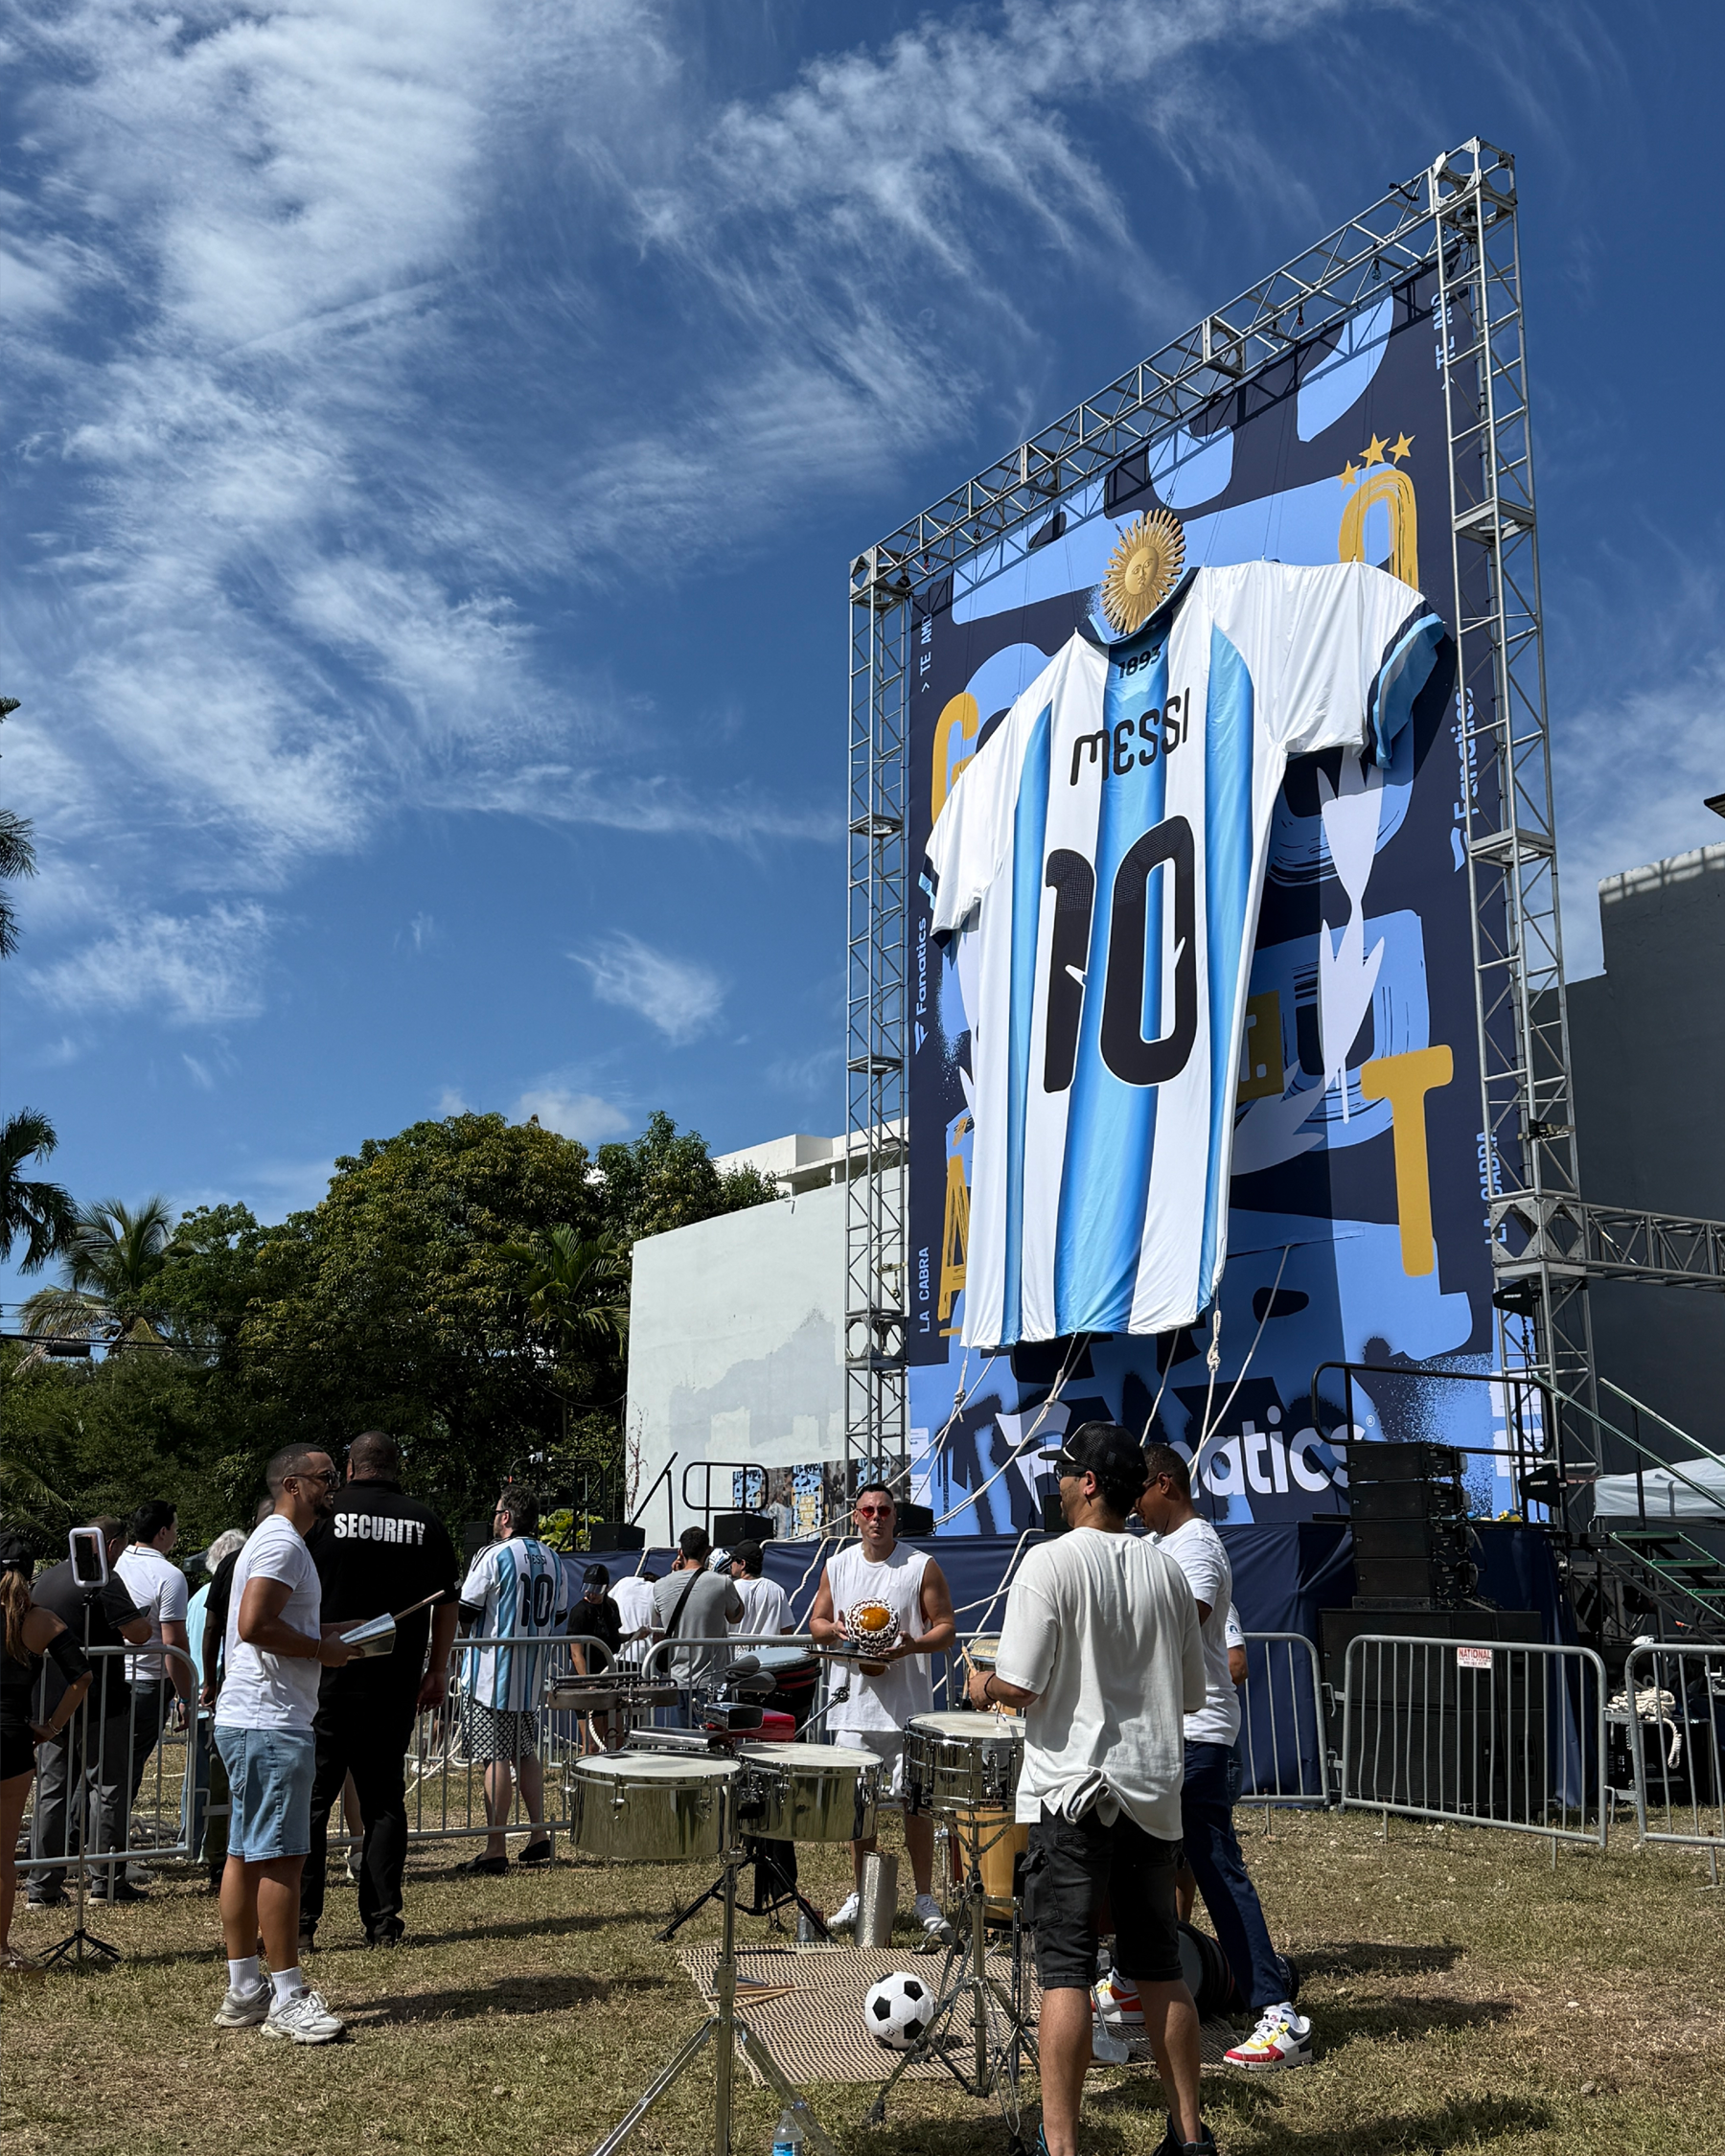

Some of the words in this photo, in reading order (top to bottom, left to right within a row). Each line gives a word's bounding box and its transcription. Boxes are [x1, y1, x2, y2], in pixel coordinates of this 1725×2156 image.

[921, 613, 932, 645] AMO
[920, 652, 932, 677] TE
[1118, 643, 1162, 679] 1893
[1070, 687, 1190, 786] MESSI
[1451, 687, 1480, 820] Fanatics
[916, 916, 927, 1016] Fanatics
[1044, 815, 1198, 1093] 10
[918, 1247, 931, 1301] CABRA
[919, 1310, 931, 1333] LA
[1171, 1405, 1366, 1499] atics
[334, 1513, 426, 1546] SECURITY
[519, 1572, 553, 1627] 10
[1459, 1648, 1491, 1659] NATIONAL
